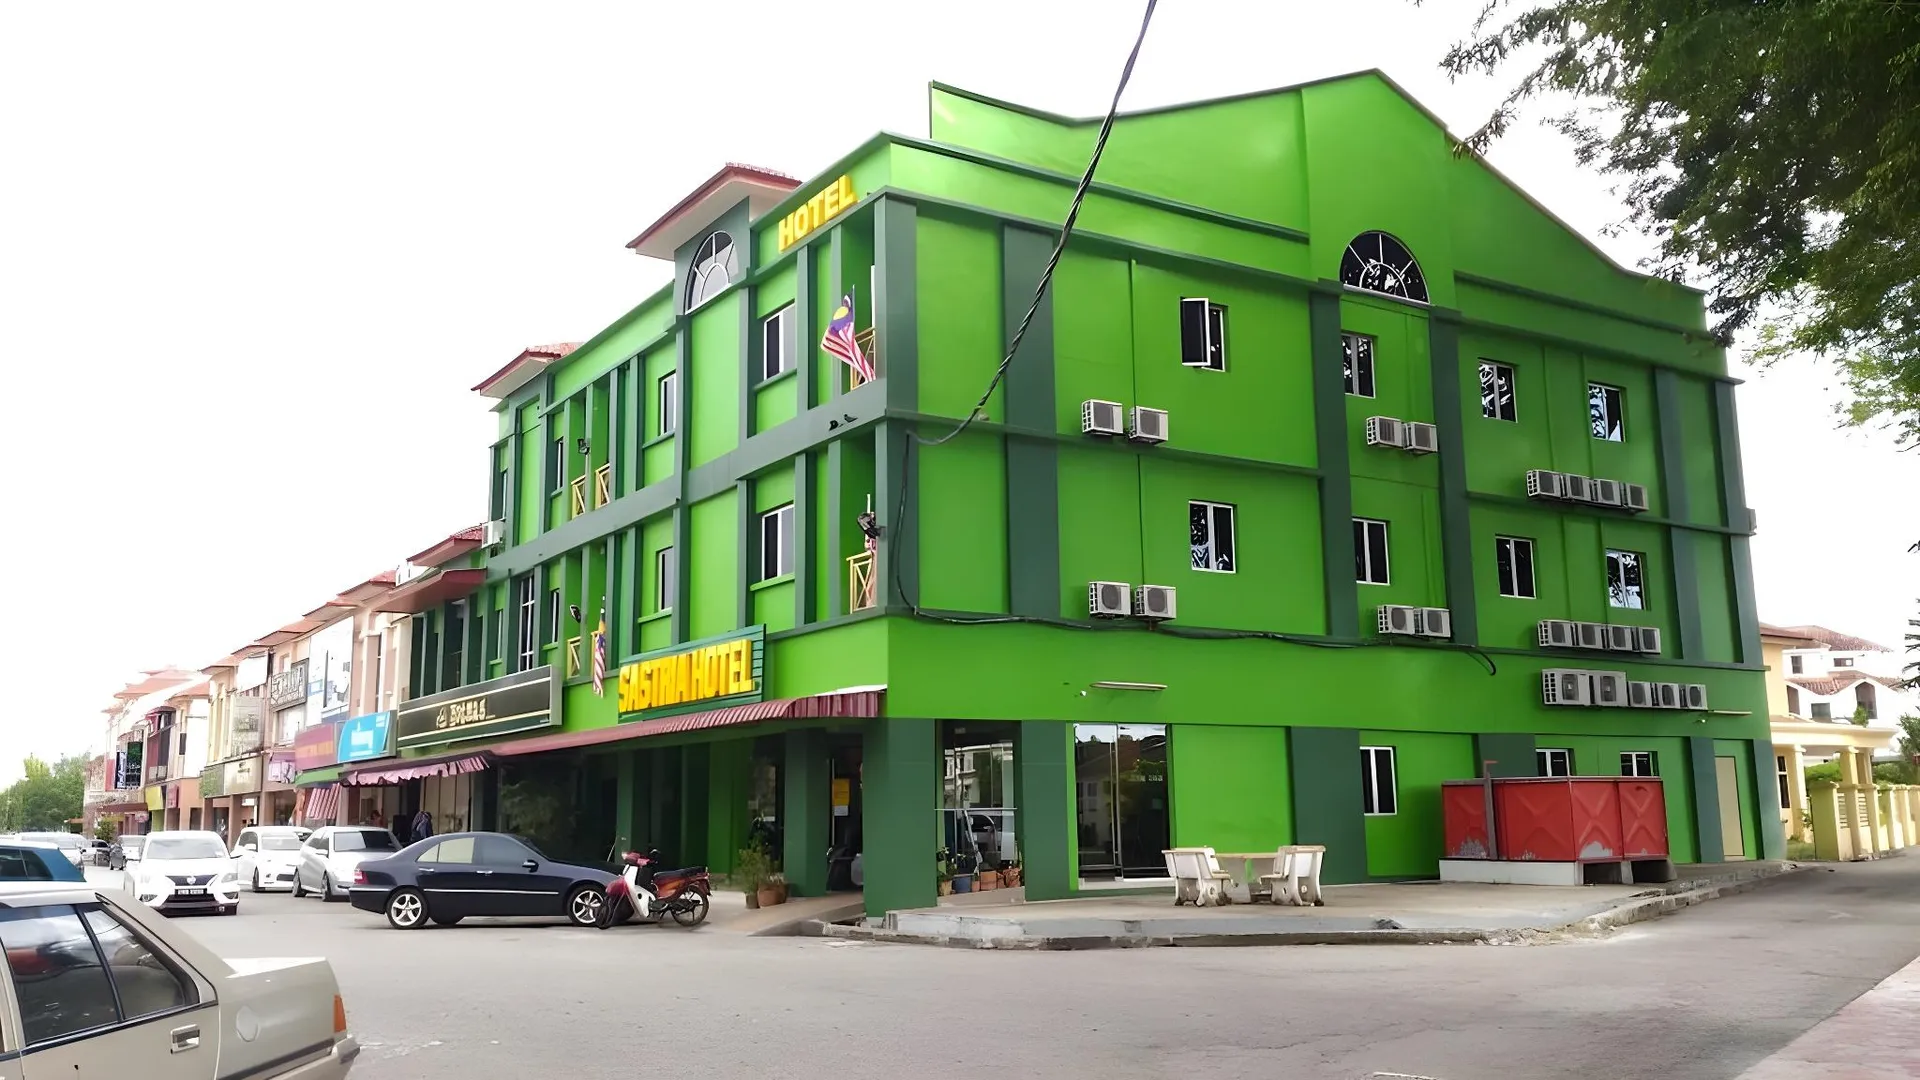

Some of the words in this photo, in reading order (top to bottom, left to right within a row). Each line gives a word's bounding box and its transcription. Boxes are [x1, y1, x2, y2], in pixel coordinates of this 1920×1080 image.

[778, 174, 856, 252] HOTEL
[619, 655, 690, 713] SASTRIA
[691, 639, 754, 701] HOTEL
